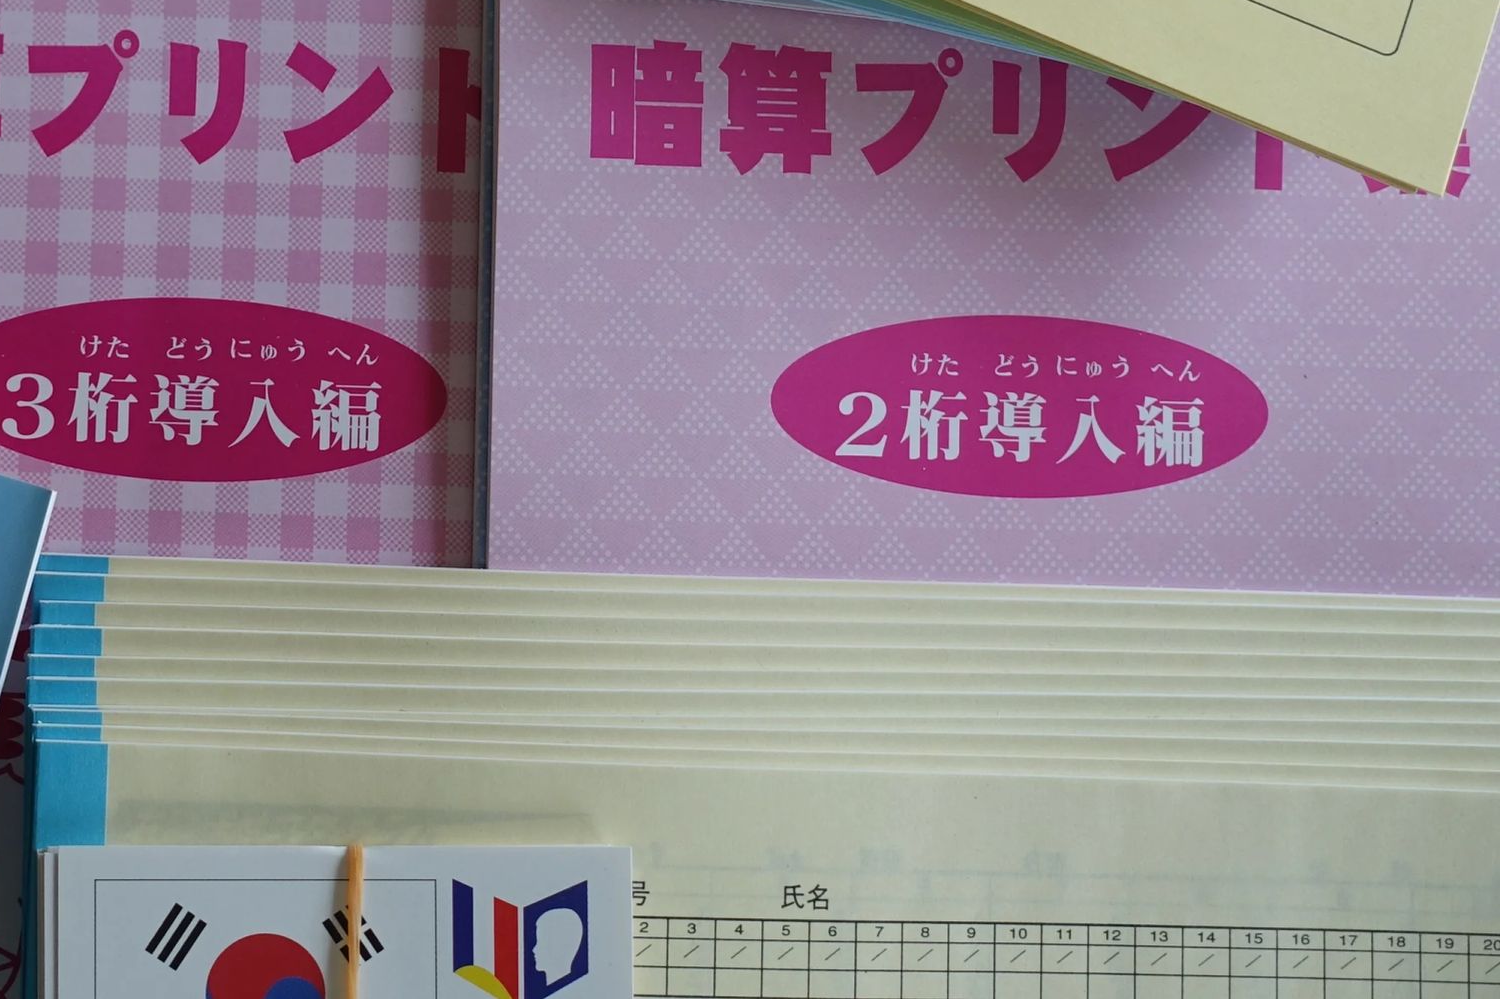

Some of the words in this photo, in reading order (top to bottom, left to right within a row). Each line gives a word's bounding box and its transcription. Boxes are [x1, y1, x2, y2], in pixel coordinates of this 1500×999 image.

[79, 335, 130, 359] けた
[910, 352, 960, 377] けた
[1, 372, 383, 452] 3桁導入編
[835, 389, 1205, 468] 2桁導入編
[781, 884, 830, 911] 氏名
[639, 921, 649, 934] 2
[687, 922, 697, 935] 3
[734, 923, 744, 937] 4
[781, 924, 791, 938] 5
[828, 925, 838, 939] 6
[875, 925, 884, 939] 7
[920, 926, 930, 939] 8
[967, 927, 976, 940] 9
[1010, 927, 1028, 941] 10
[1057, 928, 1073, 941] 11
[1104, 928, 1122, 942] 12
[1150, 930, 1169, 943] 13
[1197, 931, 1216, 944] 14
[1245, 932, 1263, 945] 15
[1292, 933, 1311, 946] 16
[1339, 934, 1358, 947] 17
[1387, 936, 1406, 949] 18
[1436, 937, 1454, 951] 19
